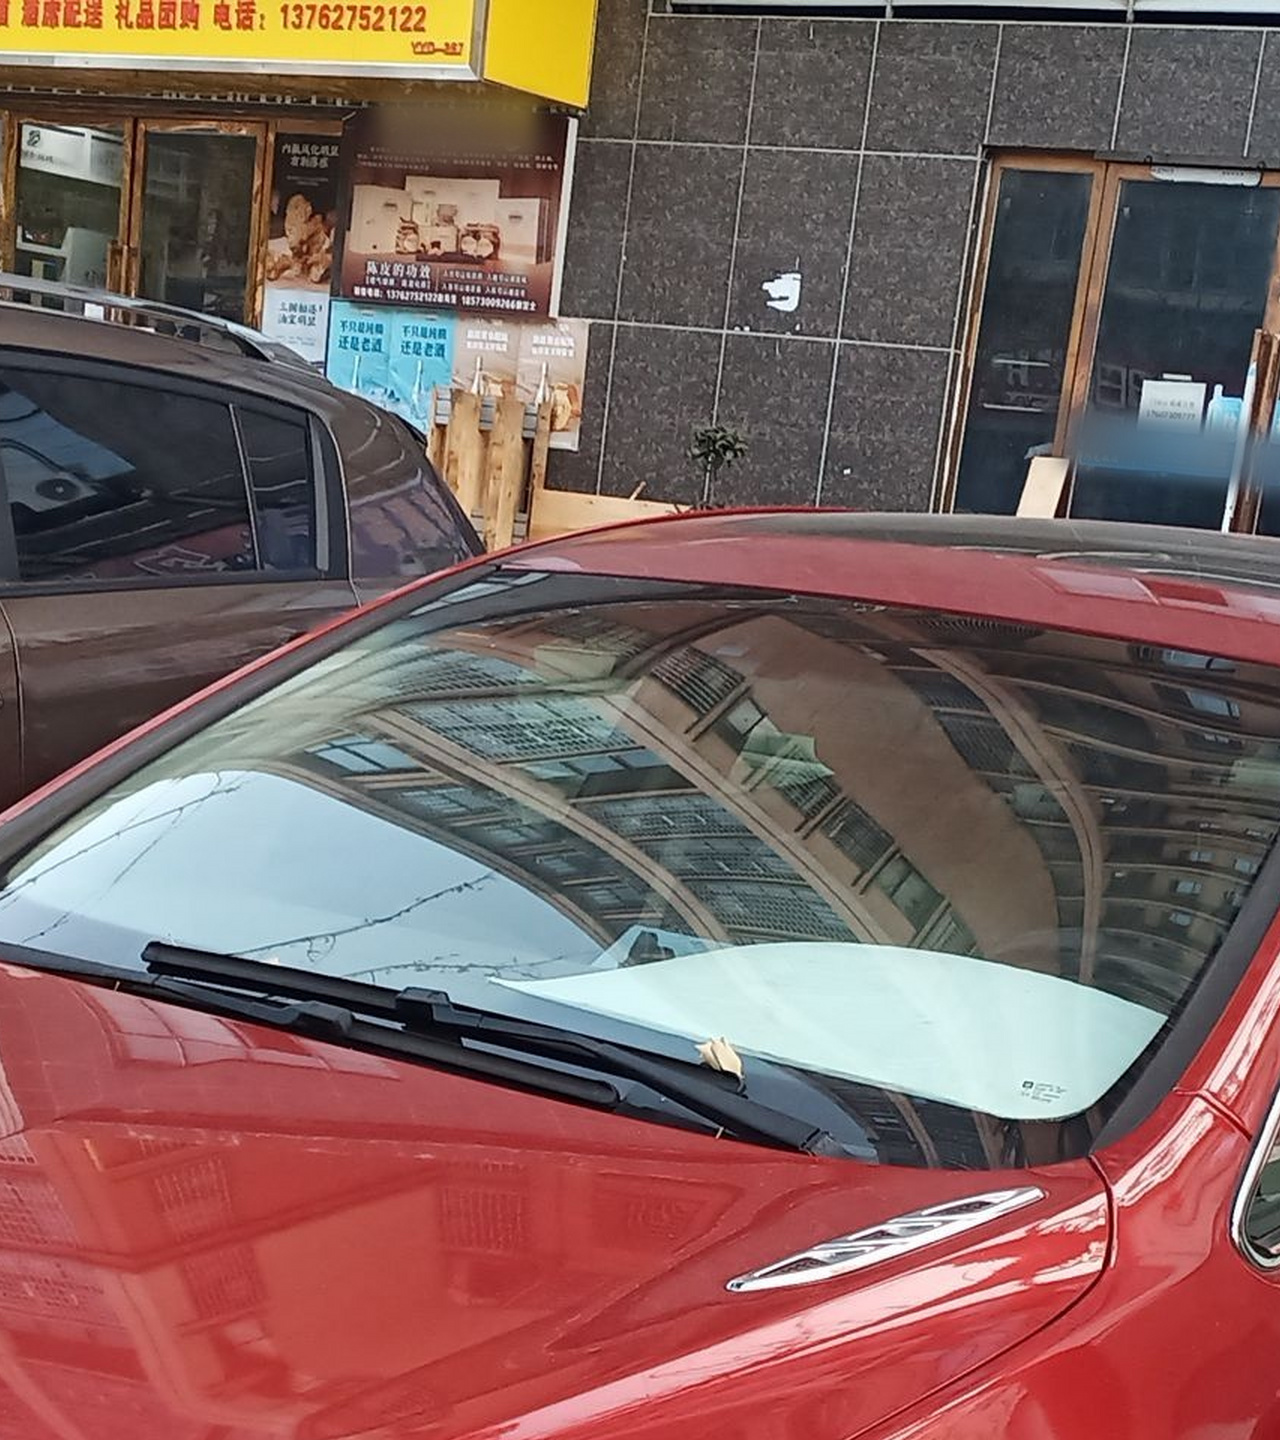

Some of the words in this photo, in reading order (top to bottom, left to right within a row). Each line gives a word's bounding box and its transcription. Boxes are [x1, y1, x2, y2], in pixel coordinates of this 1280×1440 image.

[115, 0, 200, 30] 礼品团购
[280, 3, 428, 33] 13762752122
